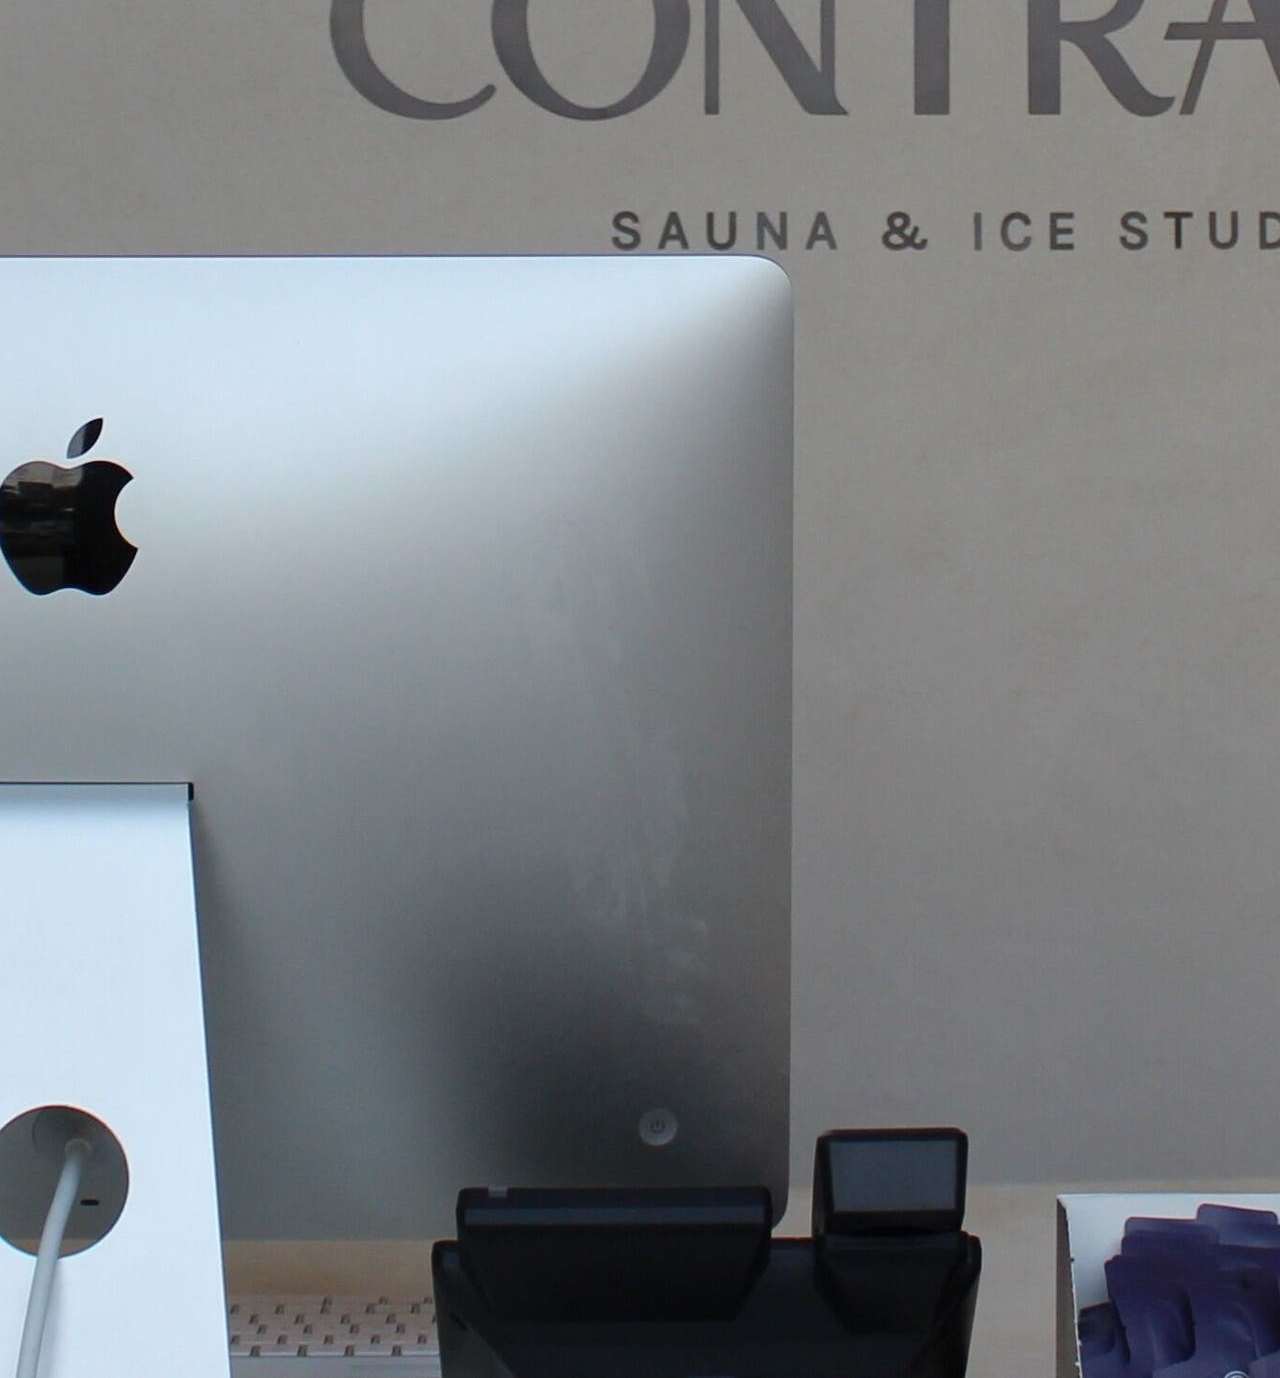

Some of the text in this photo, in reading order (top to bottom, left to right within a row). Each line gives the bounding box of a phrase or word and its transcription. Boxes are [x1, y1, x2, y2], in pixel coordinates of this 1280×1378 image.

[611, 210, 838, 251] SAUNA
[881, 210, 929, 251] &
[973, 211, 1075, 252] ICE
